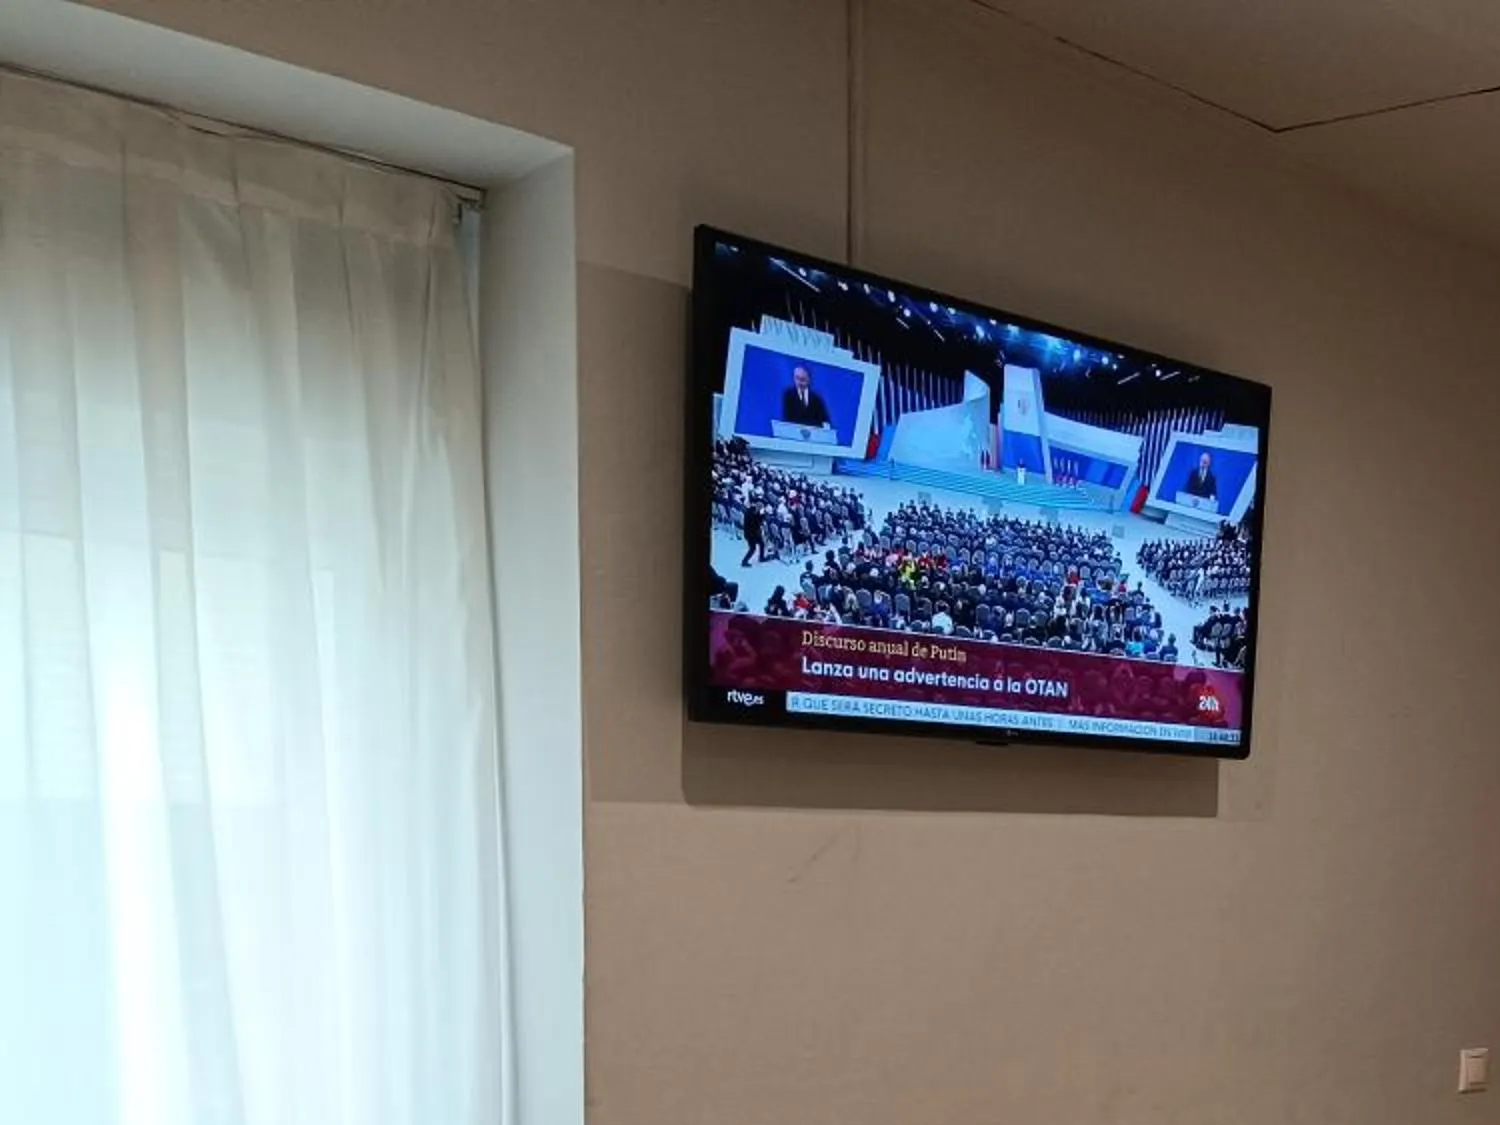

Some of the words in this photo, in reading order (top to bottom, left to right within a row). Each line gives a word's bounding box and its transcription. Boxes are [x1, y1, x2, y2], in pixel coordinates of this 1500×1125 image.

[802, 630, 866, 651] Discurso
[868, 640, 909, 657] anual
[911, 642, 928, 658] de
[930, 645, 967, 663] Putin
[802, 656, 853, 677] Lanza
[858, 667, 889, 681] una
[893, 667, 989, 690] advertencia
[993, 679, 1003, 692] a
[1007, 676, 1021, 693] la
[1025, 678, 1069, 698] OTAN
